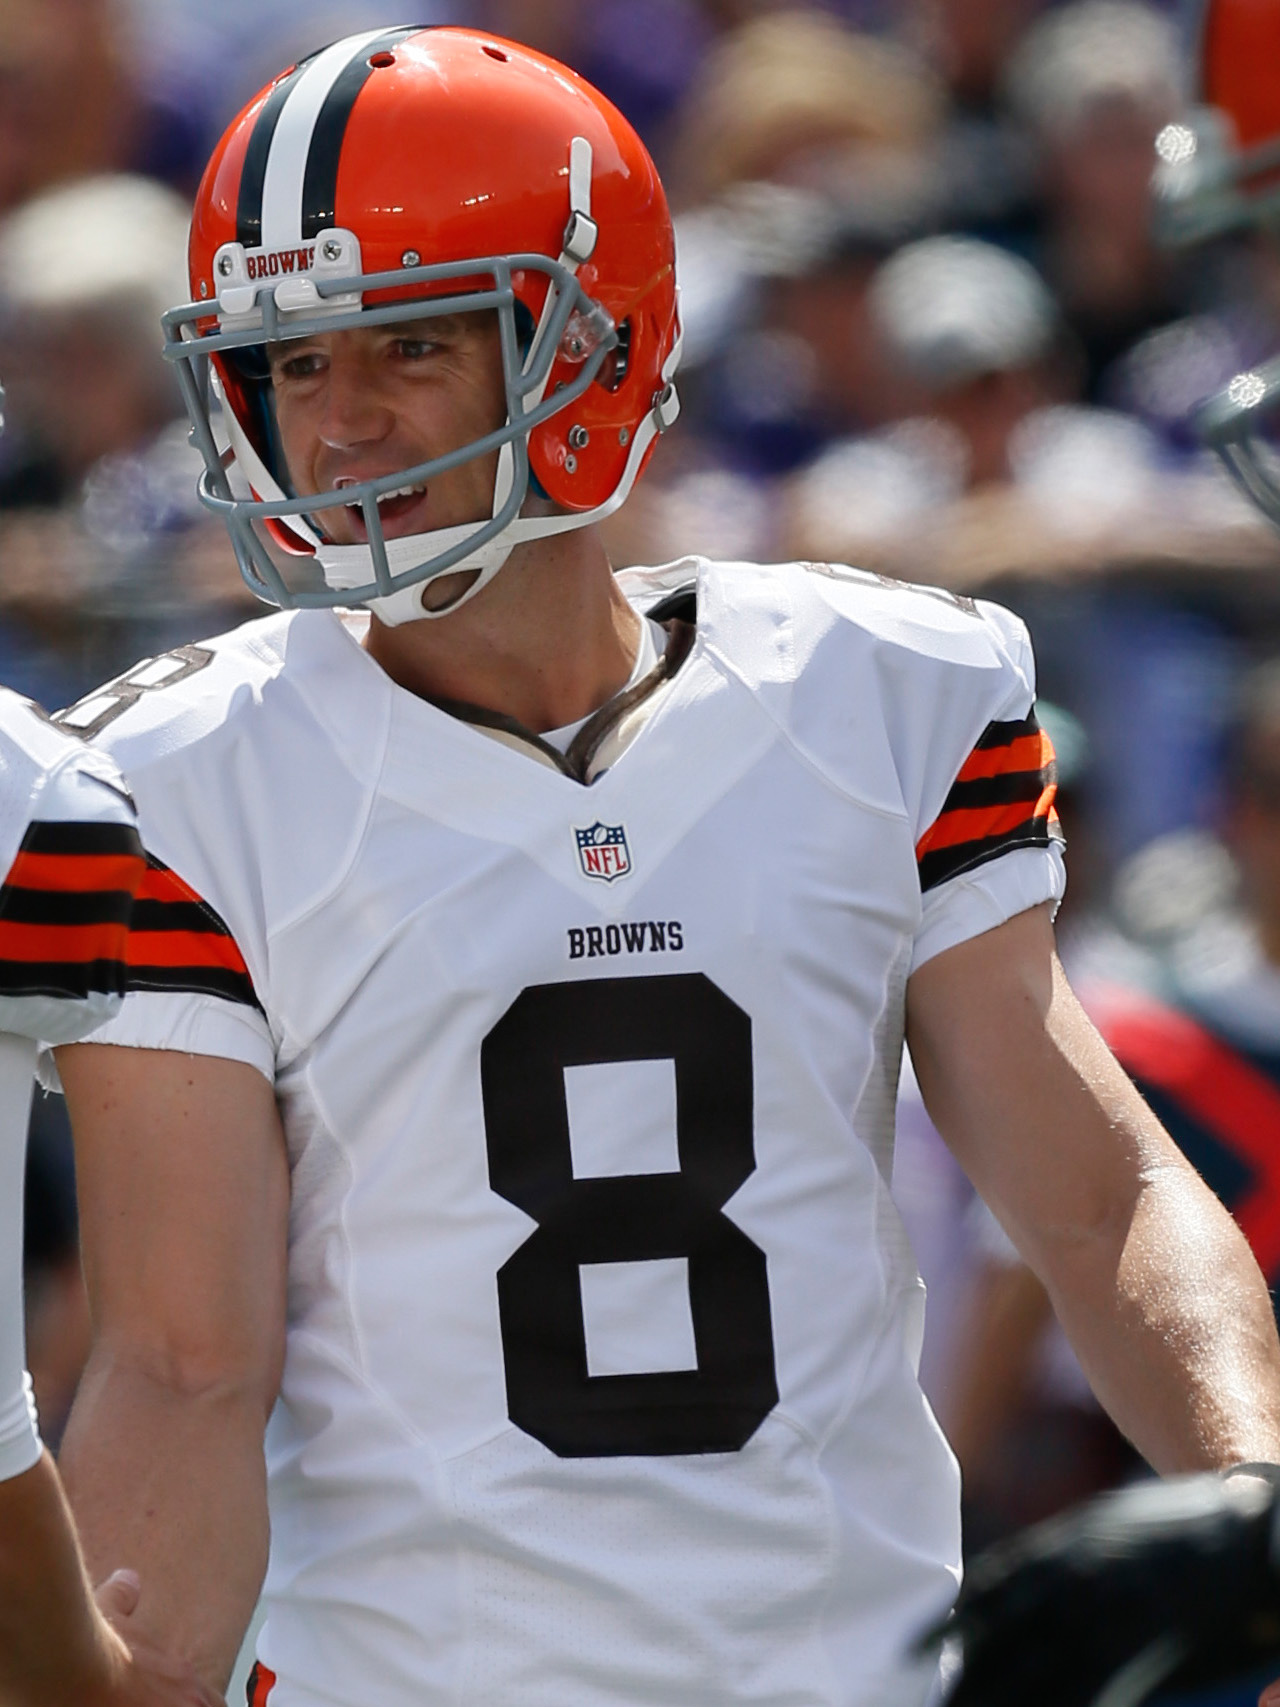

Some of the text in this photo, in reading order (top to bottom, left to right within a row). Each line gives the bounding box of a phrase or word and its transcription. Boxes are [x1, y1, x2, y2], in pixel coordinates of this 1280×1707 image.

[584, 846, 627, 875] NFL
[567, 920, 684, 959] BROWNS
[480, 972, 780, 1458] 8
